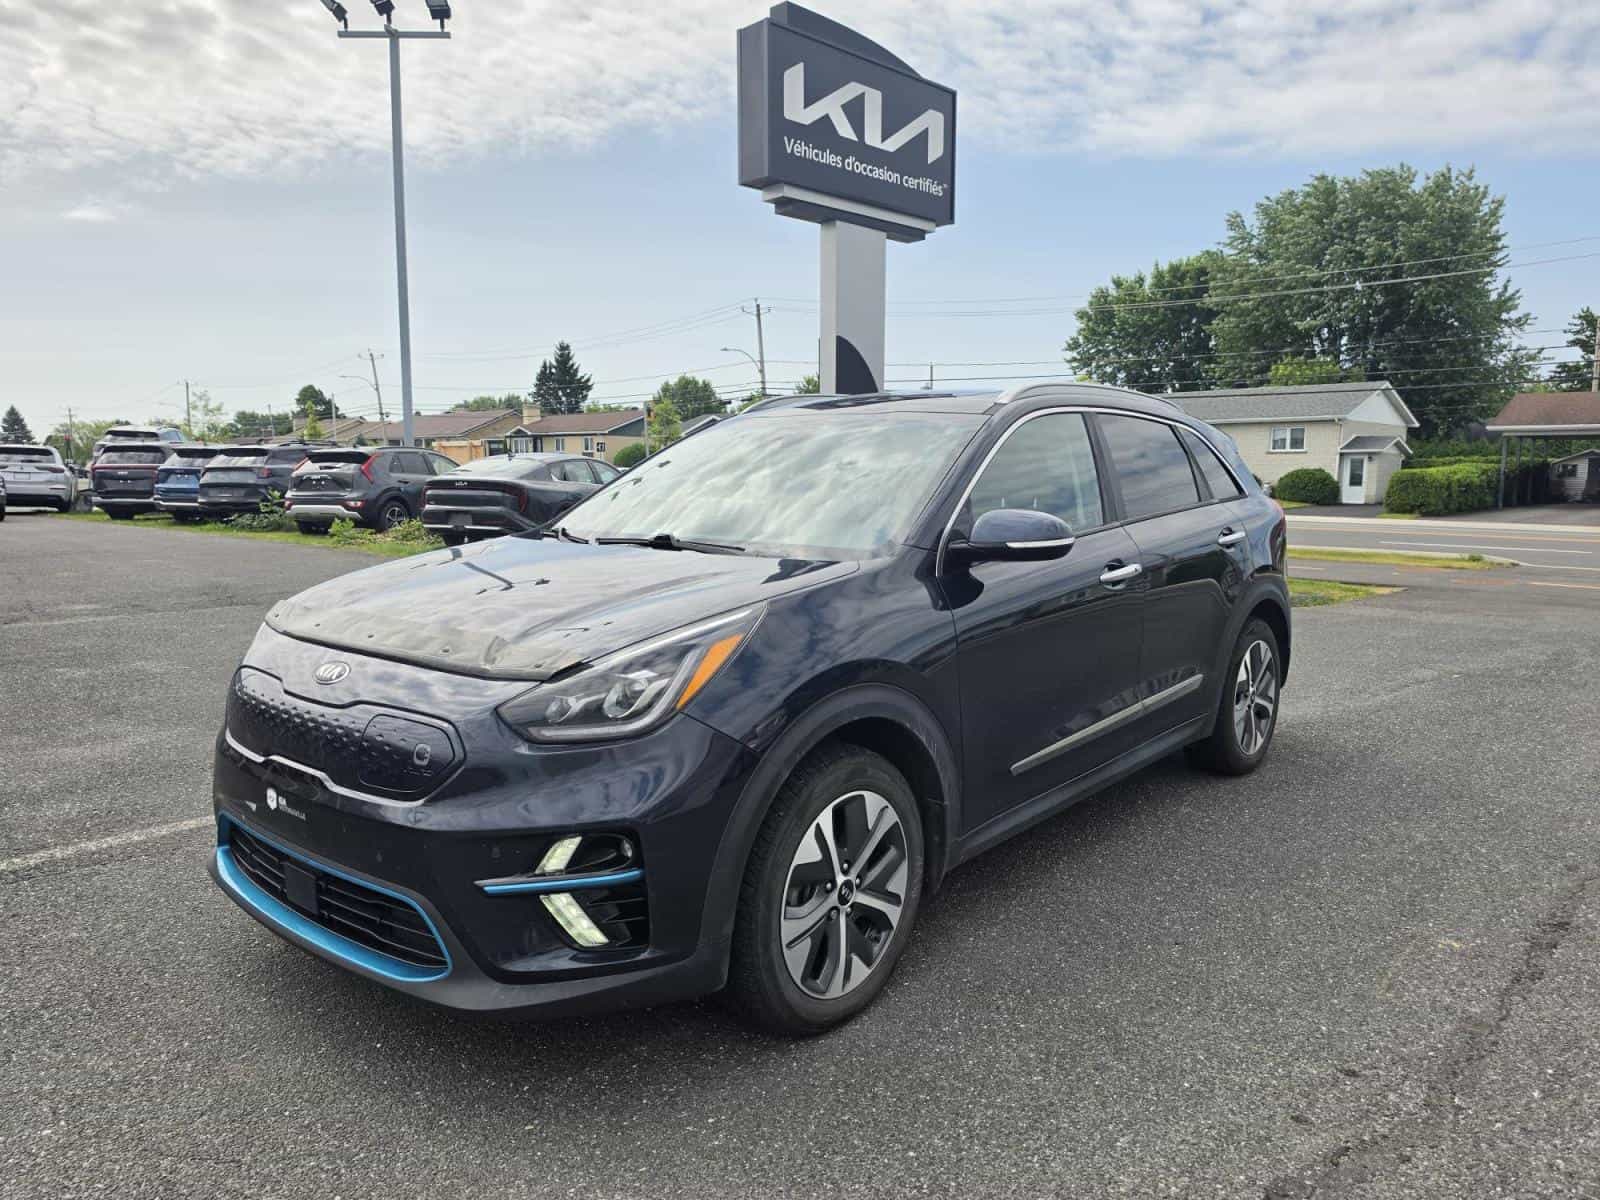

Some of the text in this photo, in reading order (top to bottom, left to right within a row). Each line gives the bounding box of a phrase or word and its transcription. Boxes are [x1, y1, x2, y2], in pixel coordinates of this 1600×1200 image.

[784, 62, 944, 164] KIA
[784, 136, 944, 196] Véhicules d'occasion certifiés
